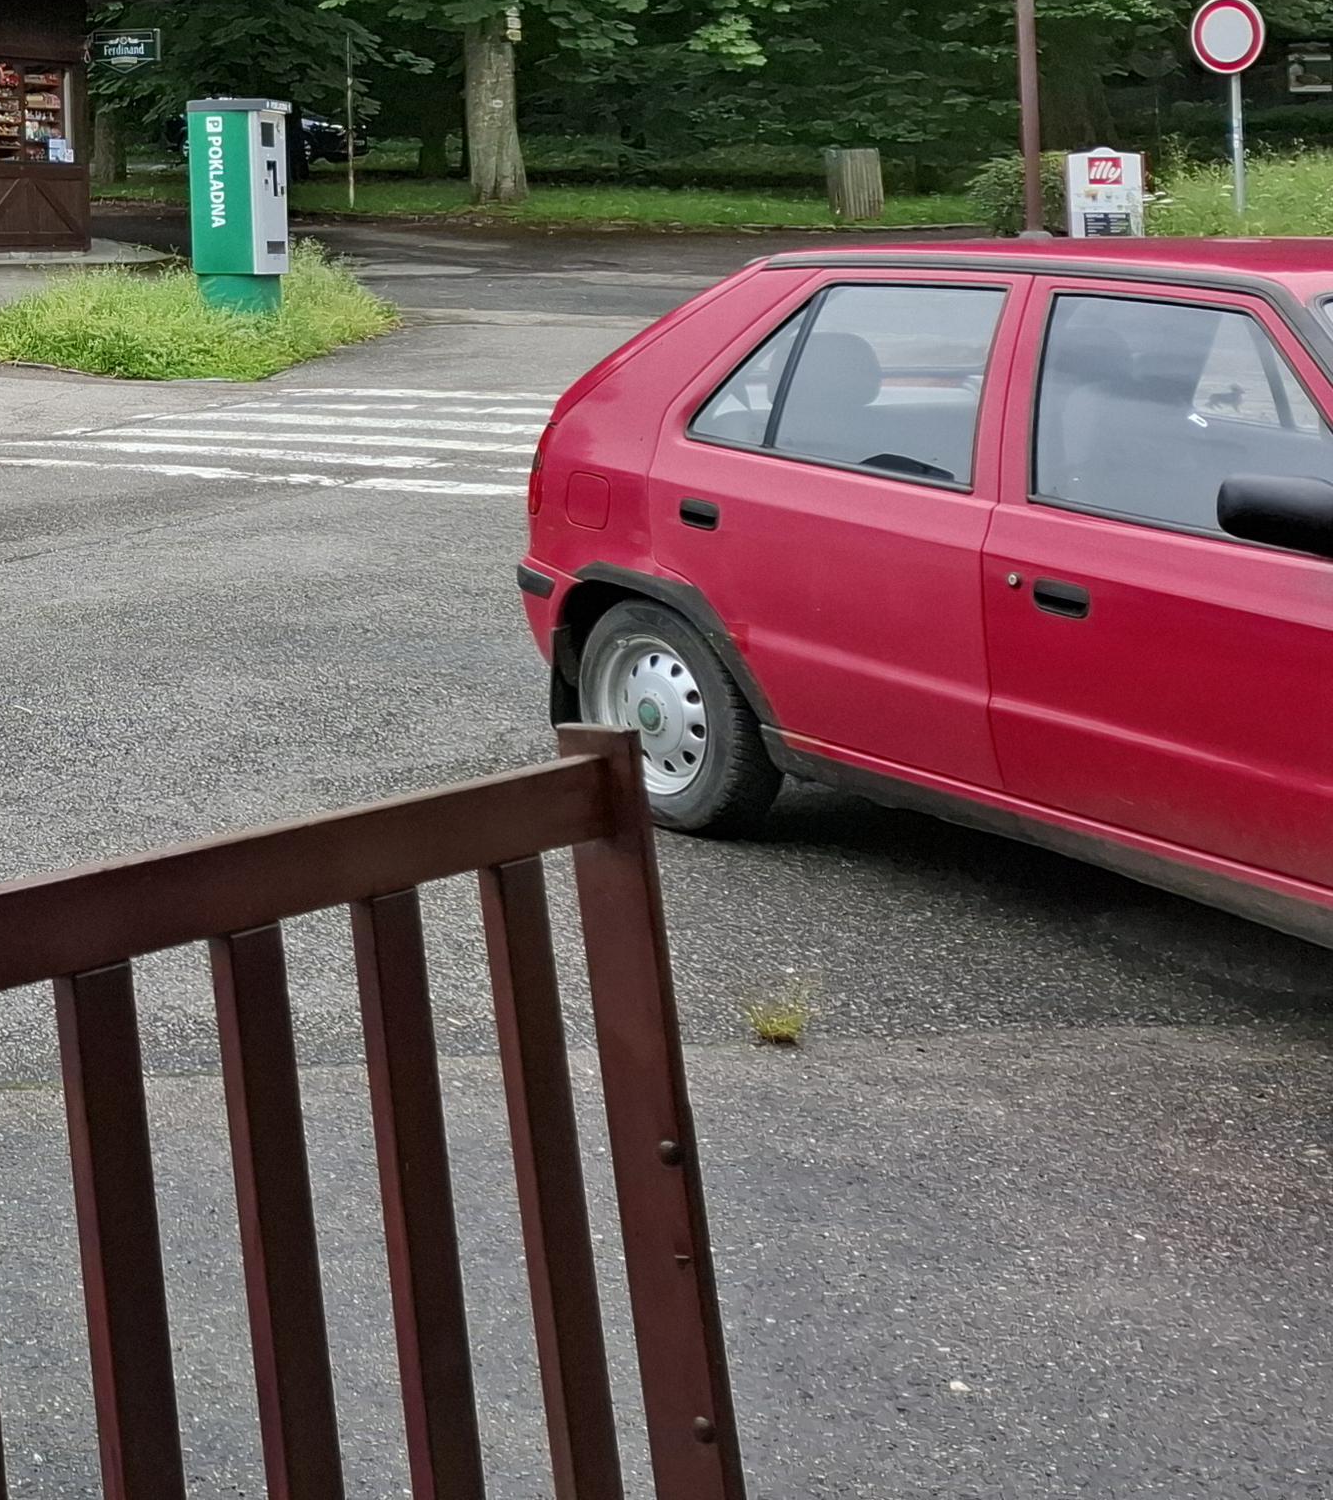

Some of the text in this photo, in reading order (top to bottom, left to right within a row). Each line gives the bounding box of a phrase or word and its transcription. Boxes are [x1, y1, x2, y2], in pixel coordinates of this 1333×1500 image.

[103, 43, 145, 56] Ferdinand
[208, 136, 226, 228] POKLADNA
[1089, 160, 1122, 184] illy
